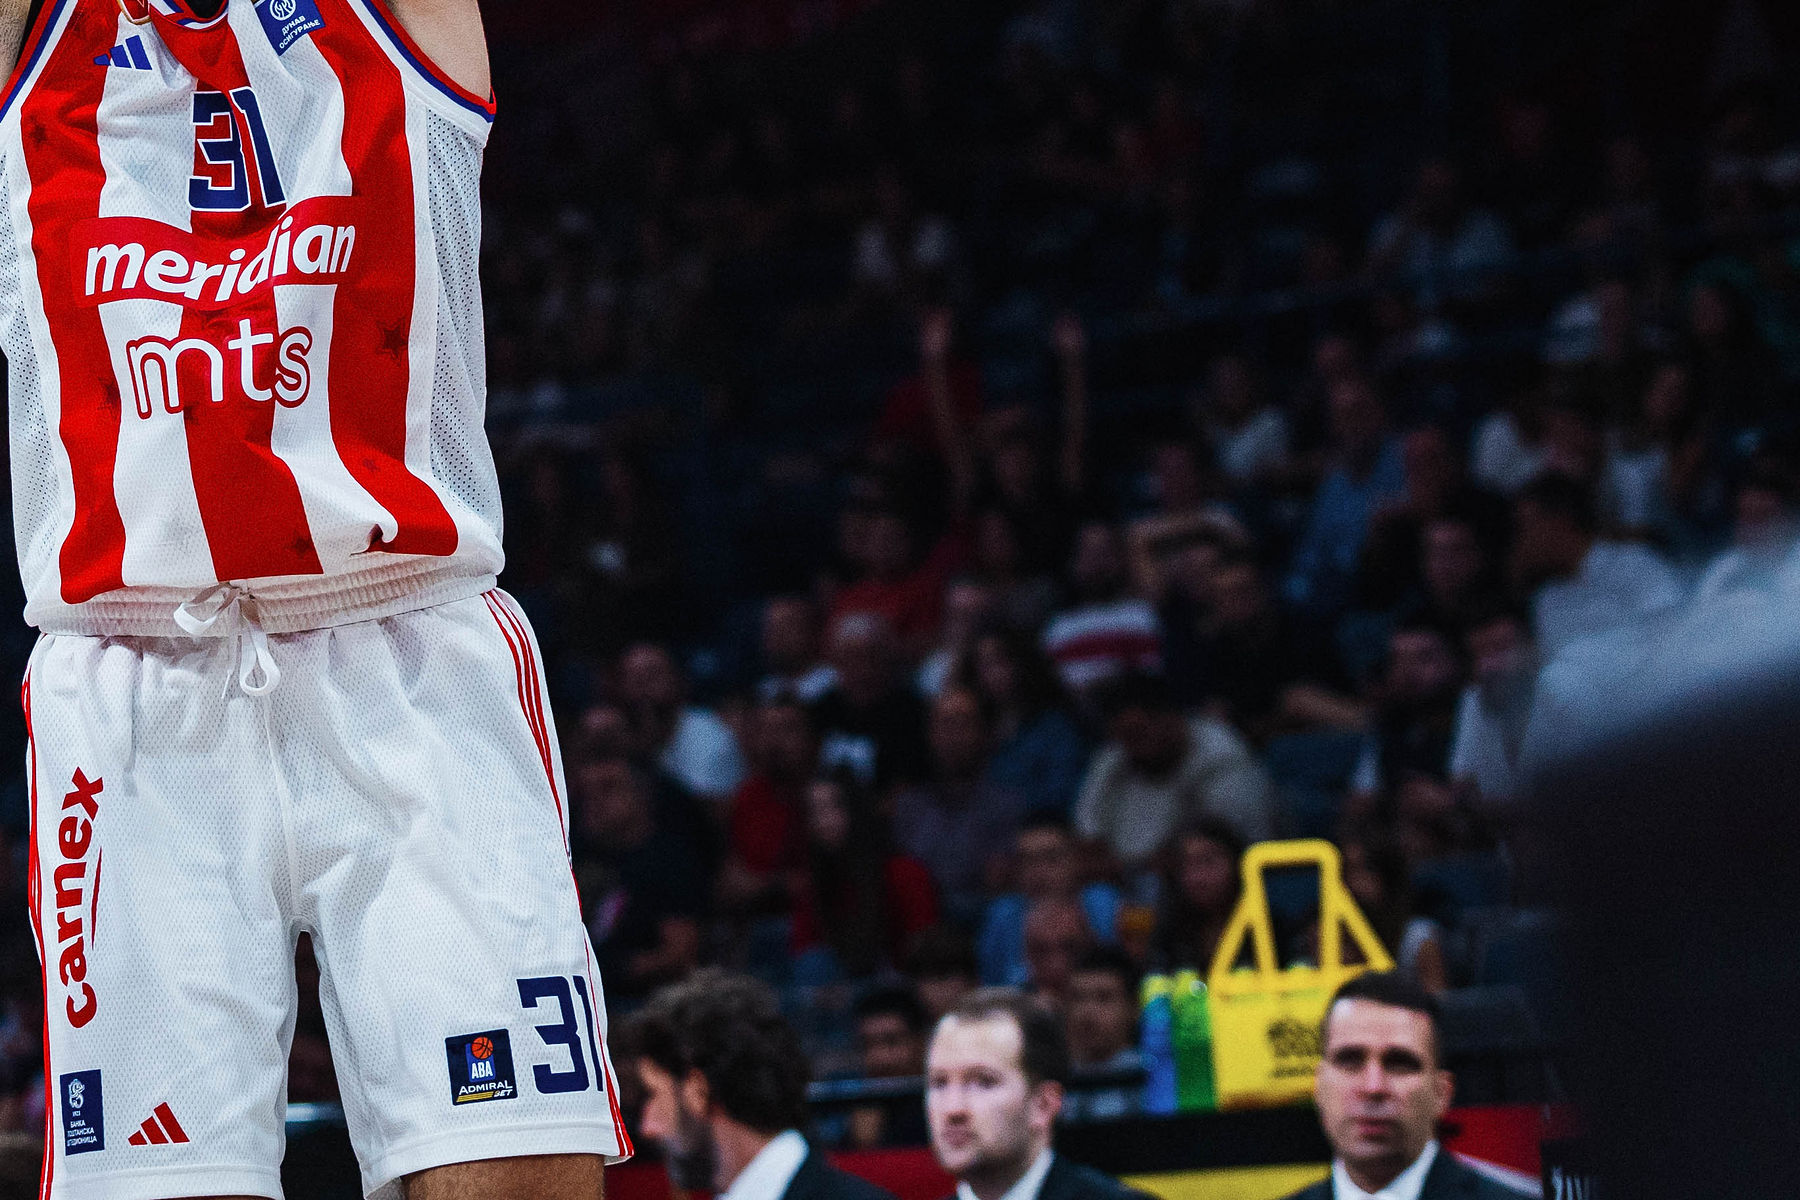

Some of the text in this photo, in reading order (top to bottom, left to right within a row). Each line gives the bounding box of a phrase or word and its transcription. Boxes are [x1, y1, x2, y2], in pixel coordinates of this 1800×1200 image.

[281, 15, 306, 37] ДУНАВ
[188, 86, 287, 212] 31
[84, 215, 356, 302] meridian
[128, 317, 312, 416] mts
[53, 766, 104, 1029] carnex
[471, 1060, 494, 1080] ABA
[516, 974, 604, 1094] 31
[458, 1079, 513, 1096] ADMIRAL
